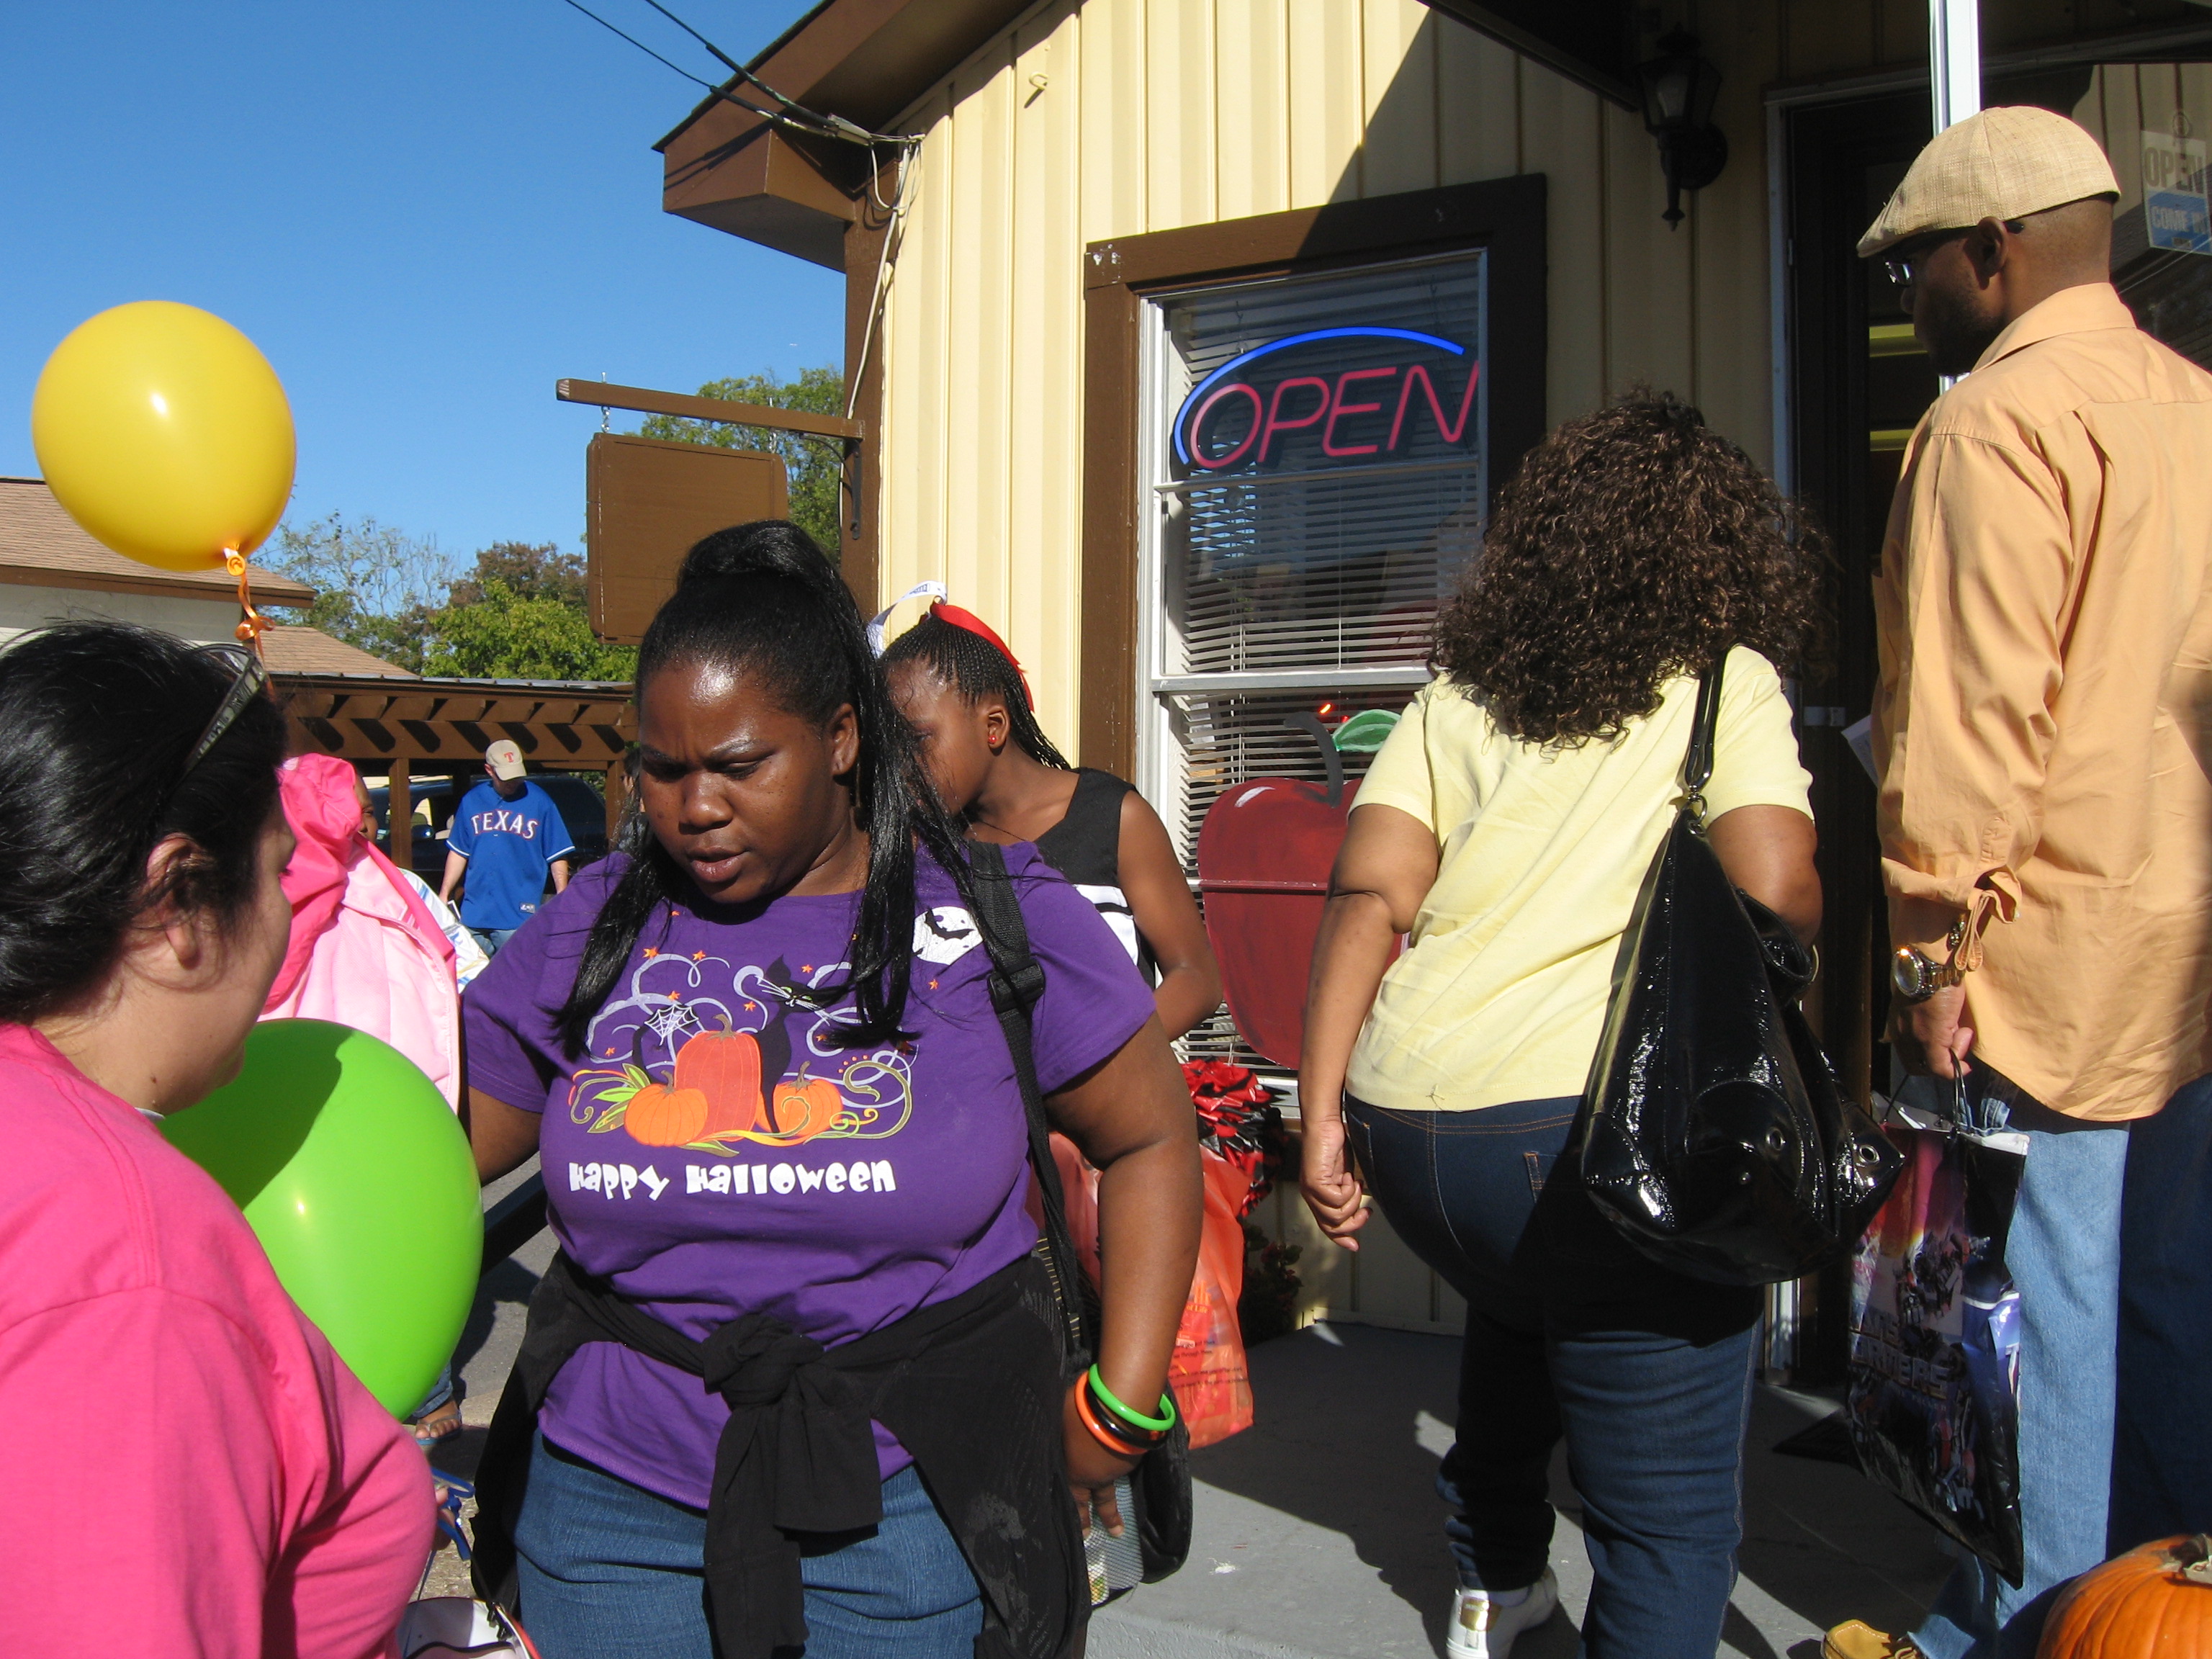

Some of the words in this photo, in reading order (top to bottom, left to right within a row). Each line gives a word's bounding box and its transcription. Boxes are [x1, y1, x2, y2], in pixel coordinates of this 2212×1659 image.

[2144, 146, 2205, 194] OPEN
[1190, 360, 1479, 469] OPEN
[503, 752, 514, 763] T
[470, 809, 539, 840] TEXAS
